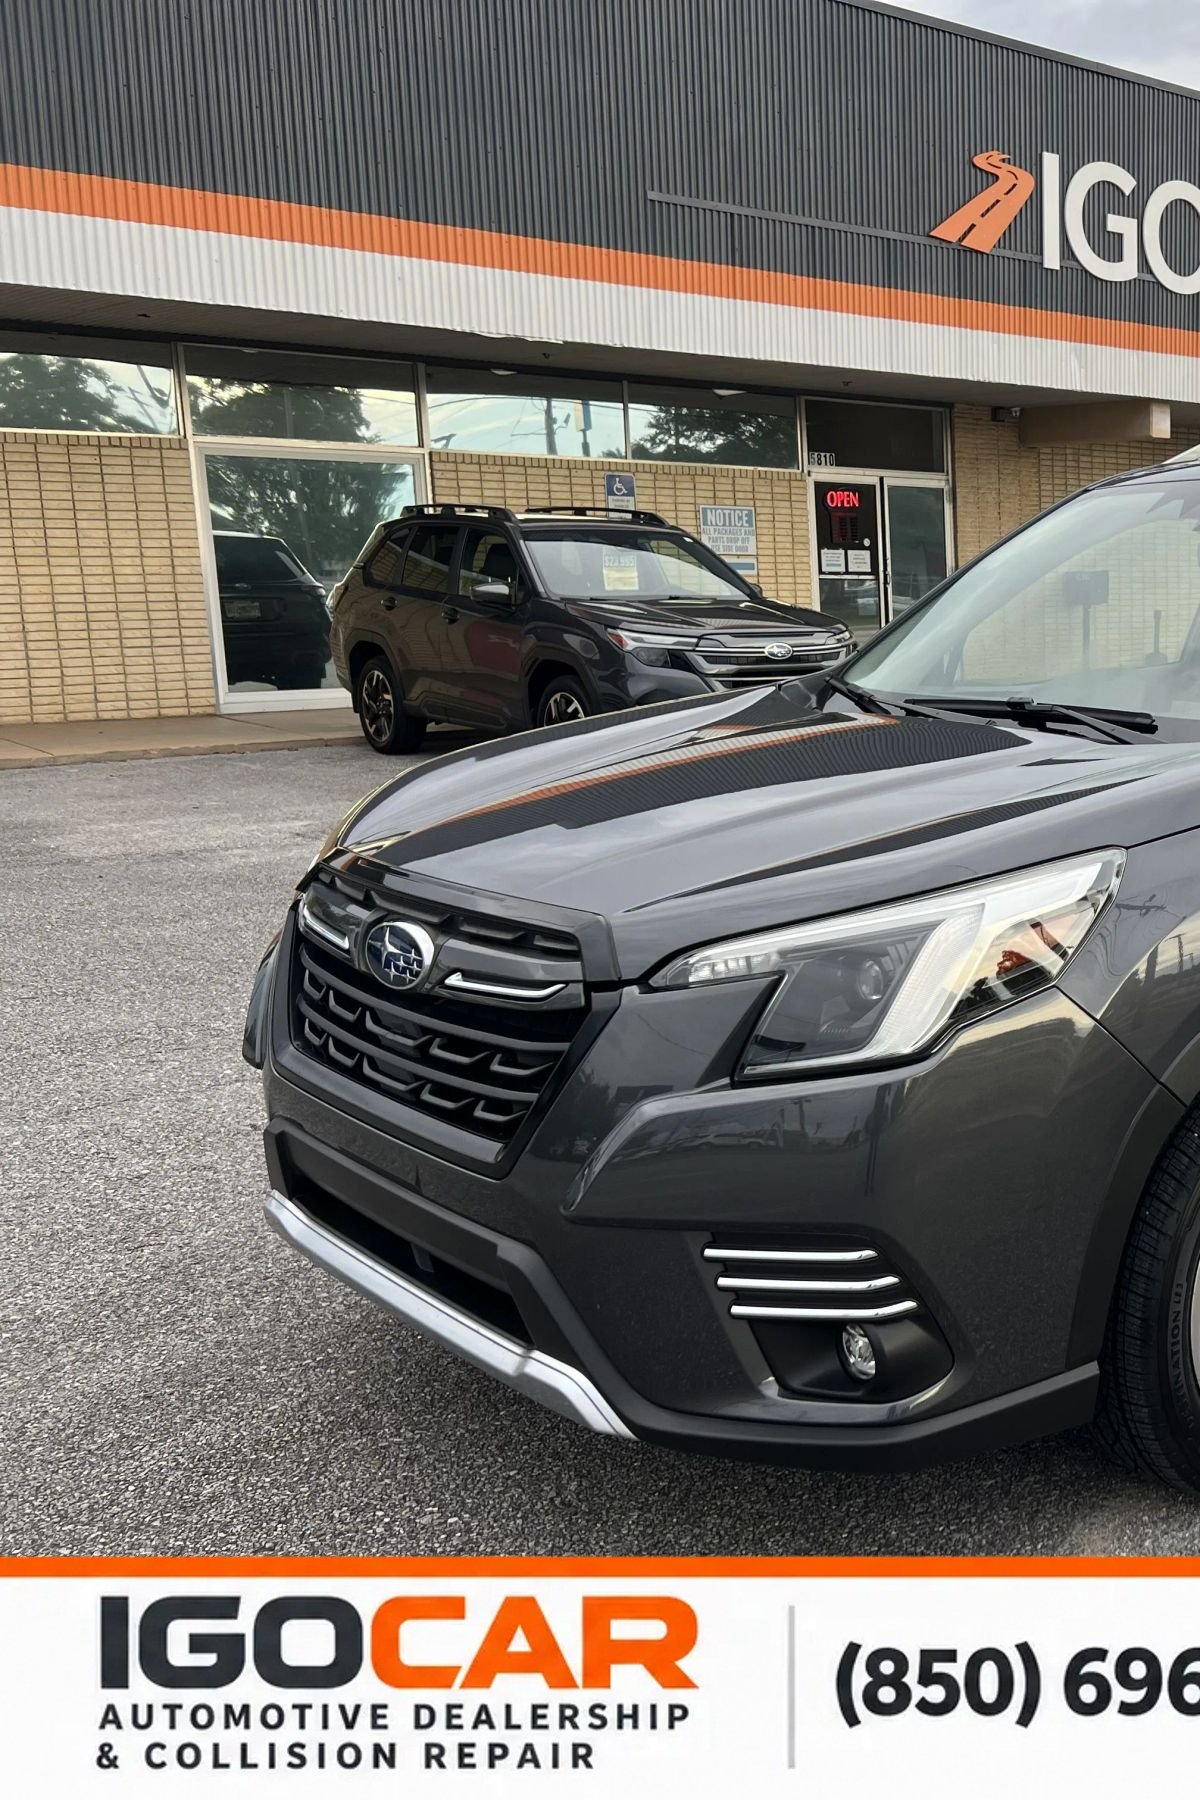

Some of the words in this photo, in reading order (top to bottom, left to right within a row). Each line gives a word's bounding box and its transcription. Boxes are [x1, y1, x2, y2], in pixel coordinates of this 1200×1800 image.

[810, 452, 835, 466] 5810
[826, 490, 859, 508] OPEN
[706, 508, 750, 527] NOTICE
[702, 527, 712, 536] ALL
[713, 527, 743, 536] PACKAGES
[743, 528, 755, 537] AND
[707, 536, 725, 544] PARTS
[726, 536, 740, 545] DROP
[741, 536, 750, 545] OFF
[722, 544, 734, 552] SIDE
[734, 545, 749, 553] DOOR
